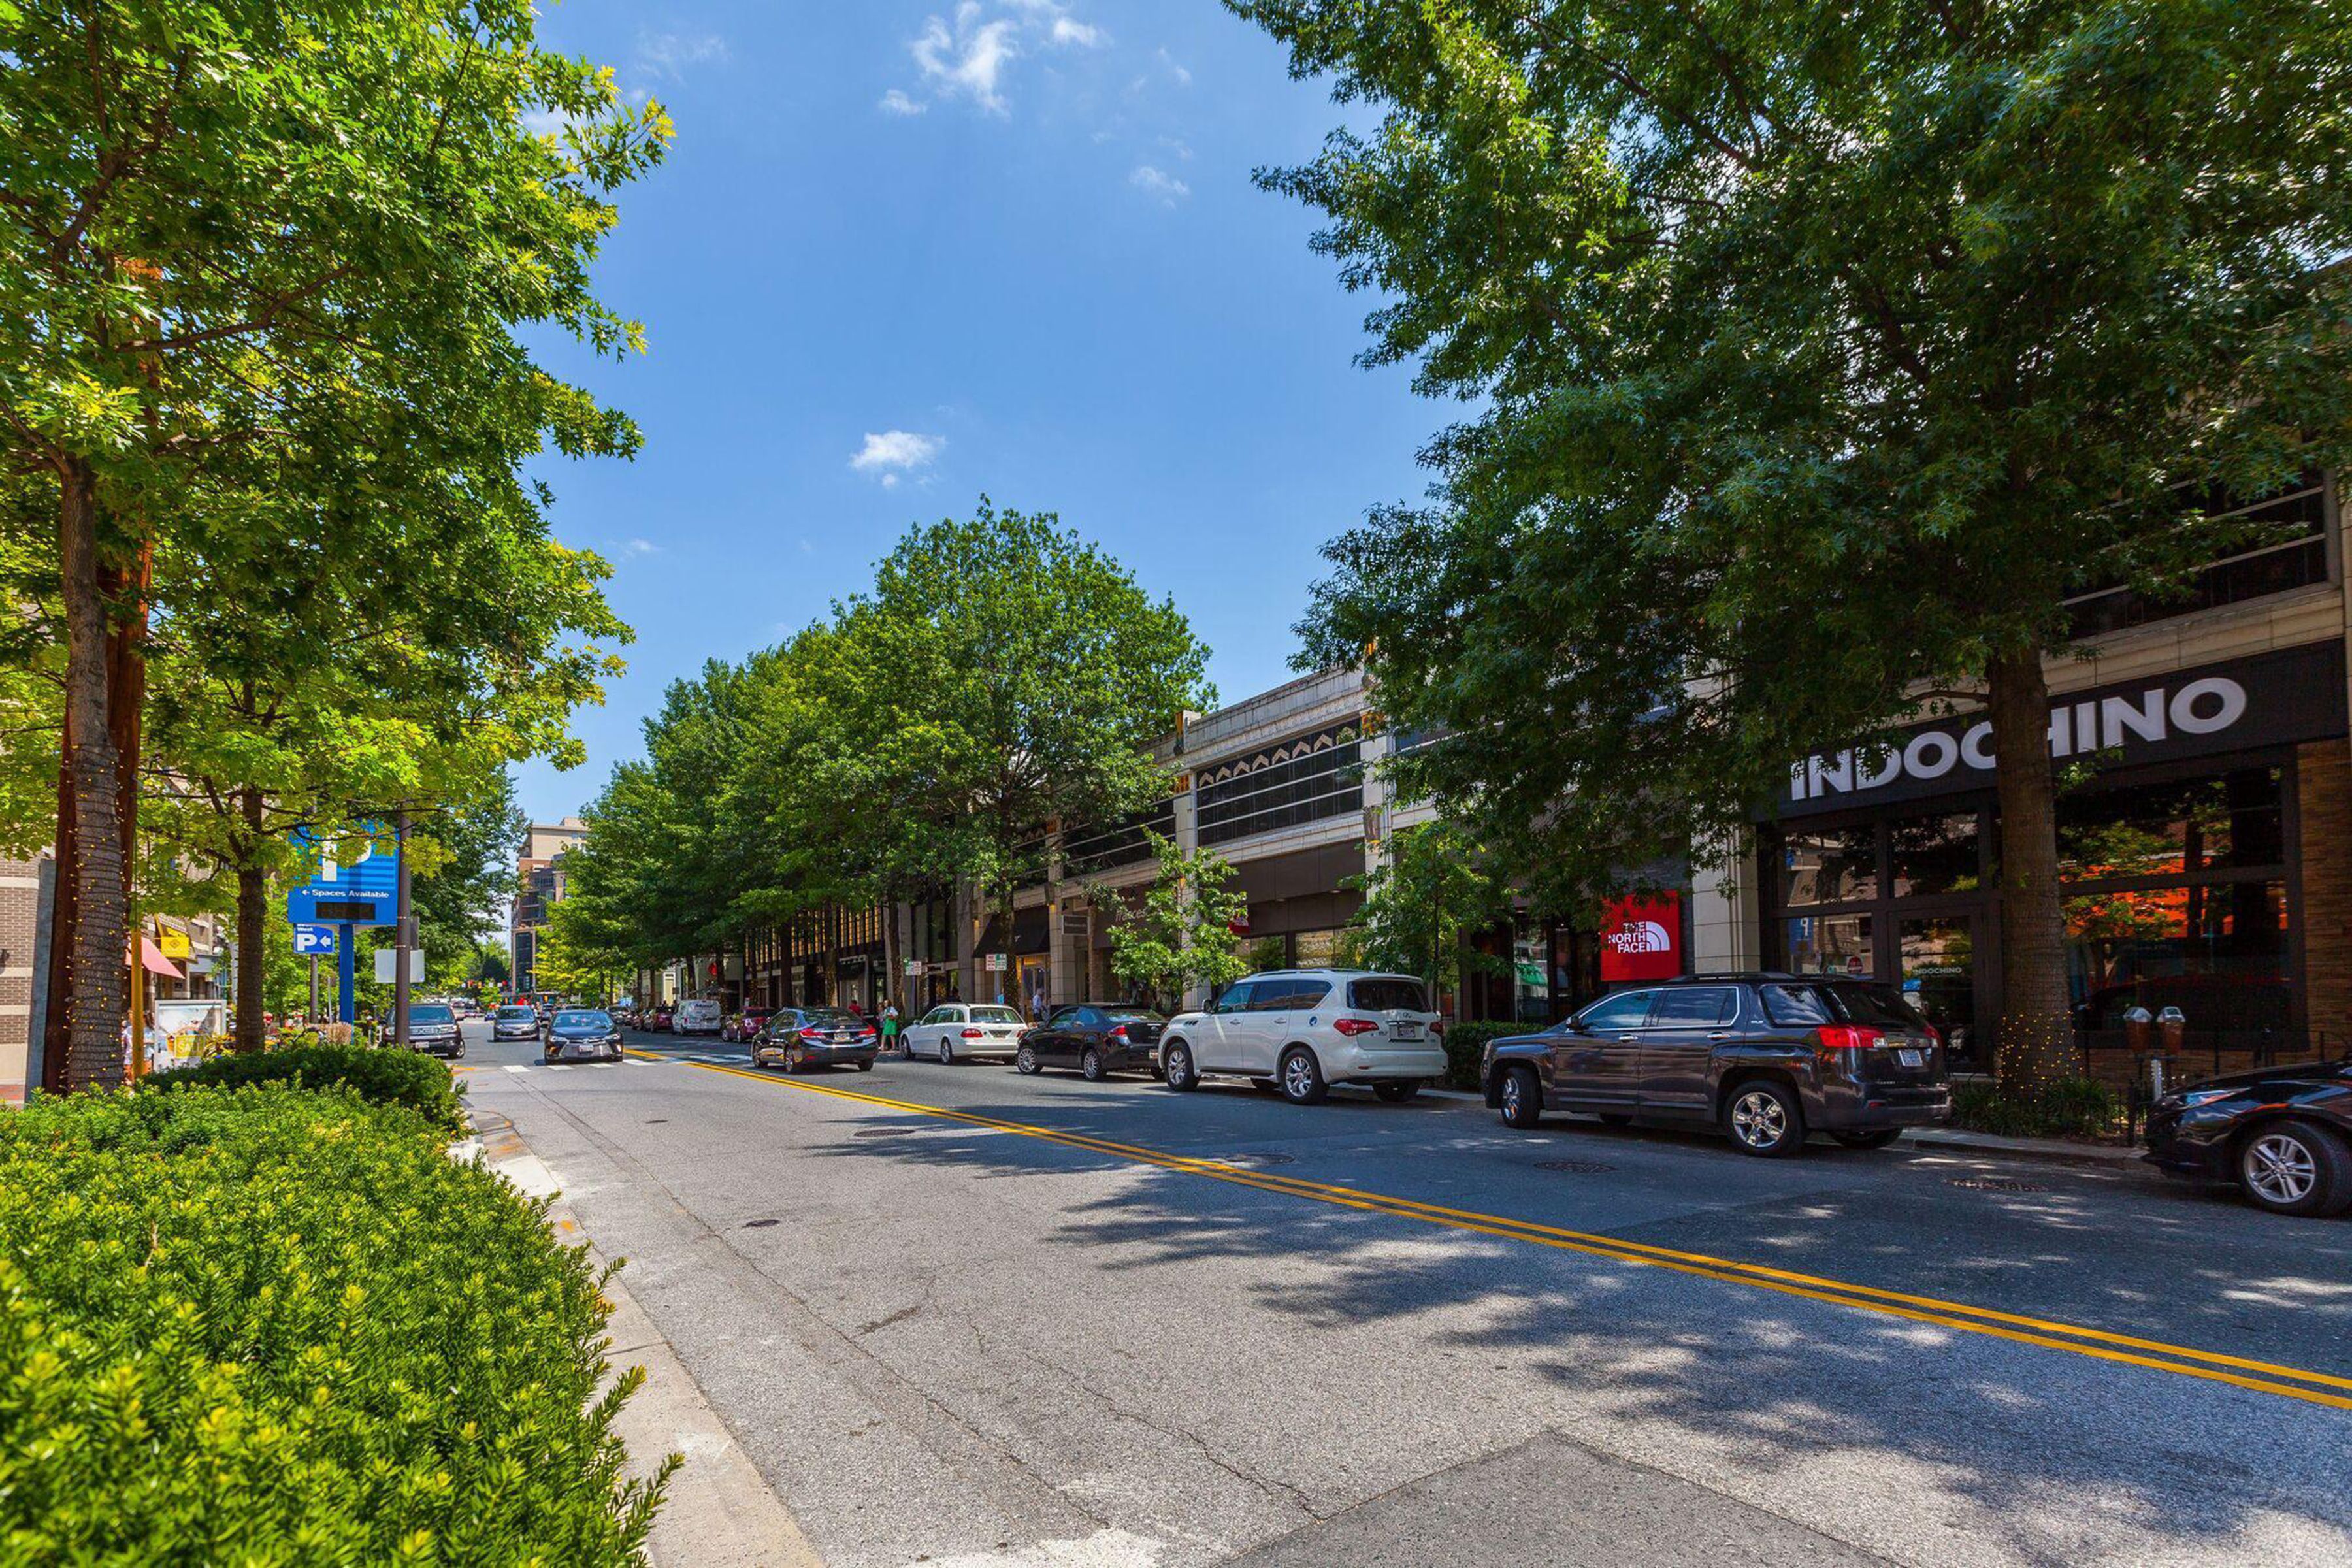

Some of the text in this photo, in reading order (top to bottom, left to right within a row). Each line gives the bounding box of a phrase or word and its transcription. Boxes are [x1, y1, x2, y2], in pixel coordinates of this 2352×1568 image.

[1623, 921, 1646, 933] THE
[297, 933, 318, 951] P
[1608, 932, 1646, 943] NORTH
[1618, 942, 1646, 953] FACE
[1912, 966, 1963, 975] INDOCHINO
